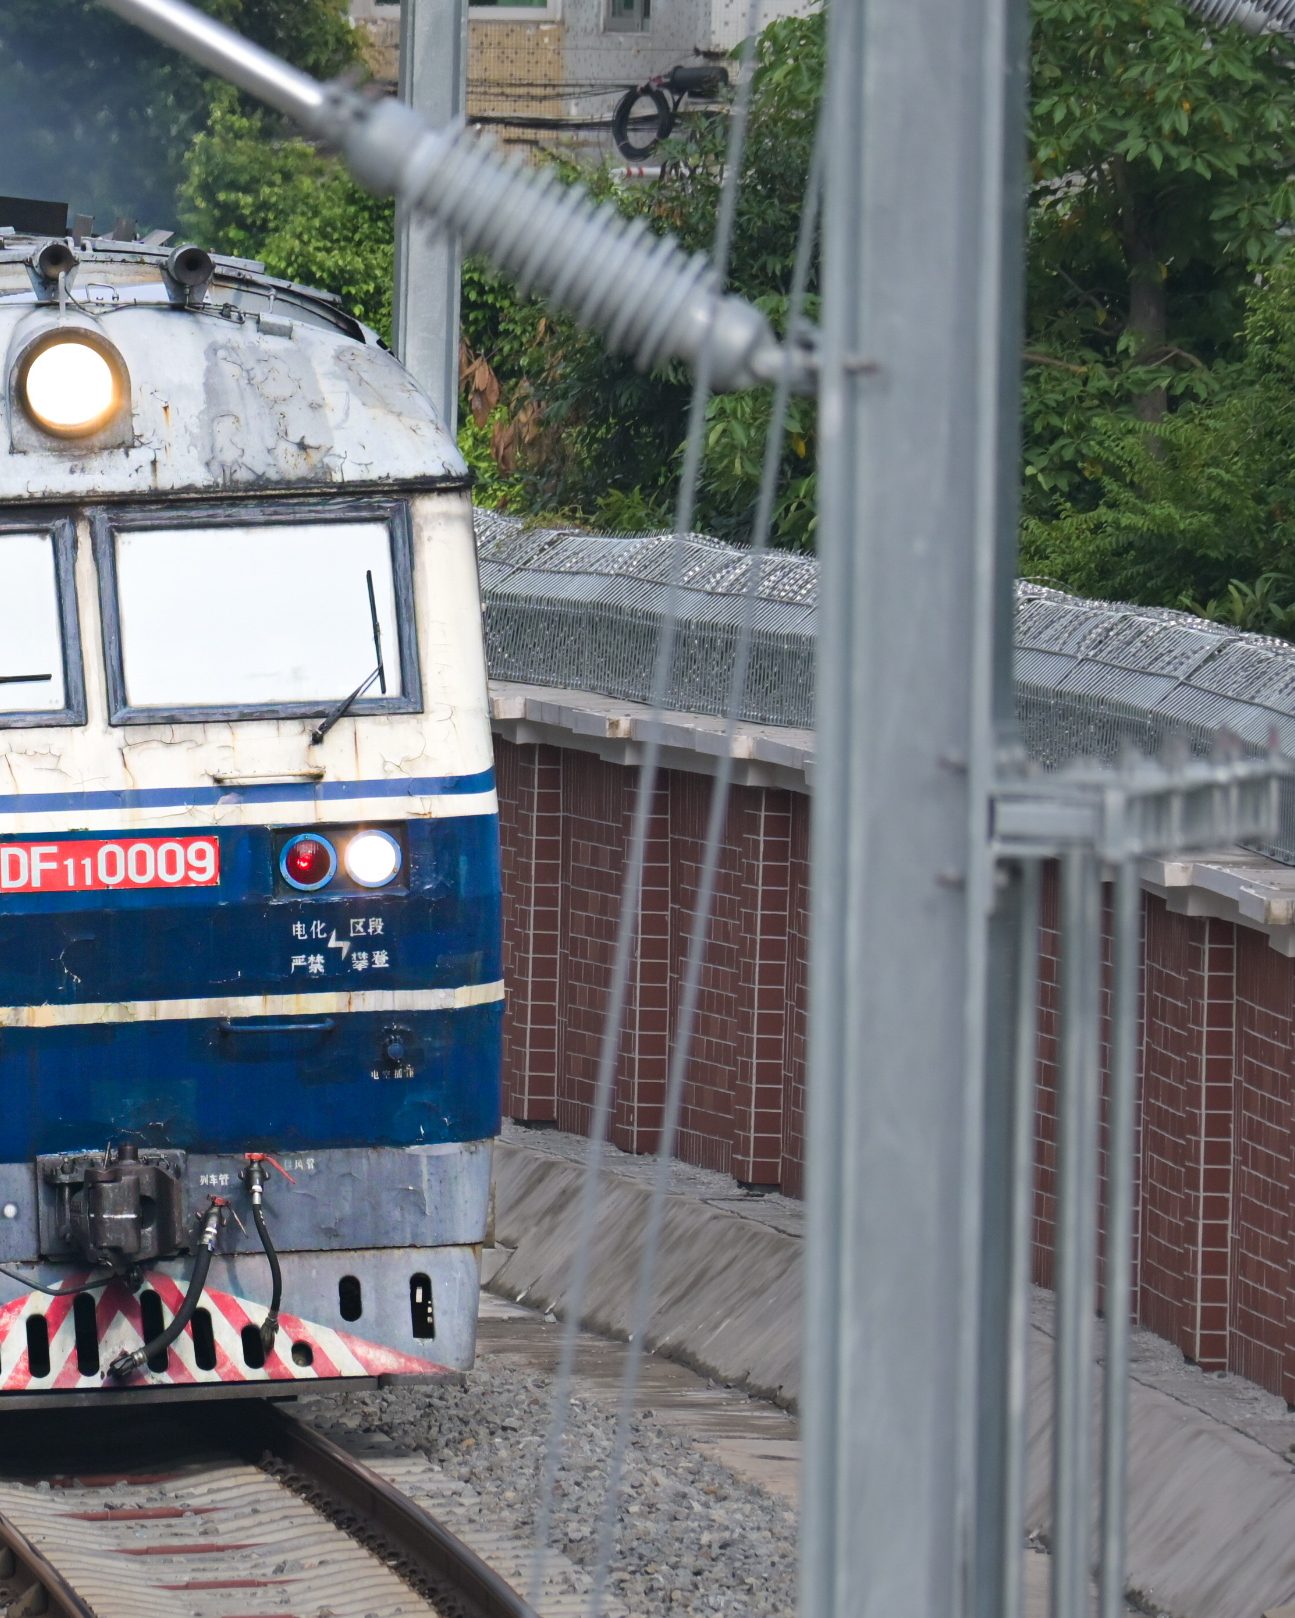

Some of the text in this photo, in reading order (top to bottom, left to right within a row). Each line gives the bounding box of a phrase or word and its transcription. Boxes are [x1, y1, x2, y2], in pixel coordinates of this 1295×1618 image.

[0, 841, 215, 888] DF110009
[292, 917, 384, 940] 电化 区段
[291, 950, 390, 974] 严禁 攀登
[199, 1173, 230, 1186] 列车管
